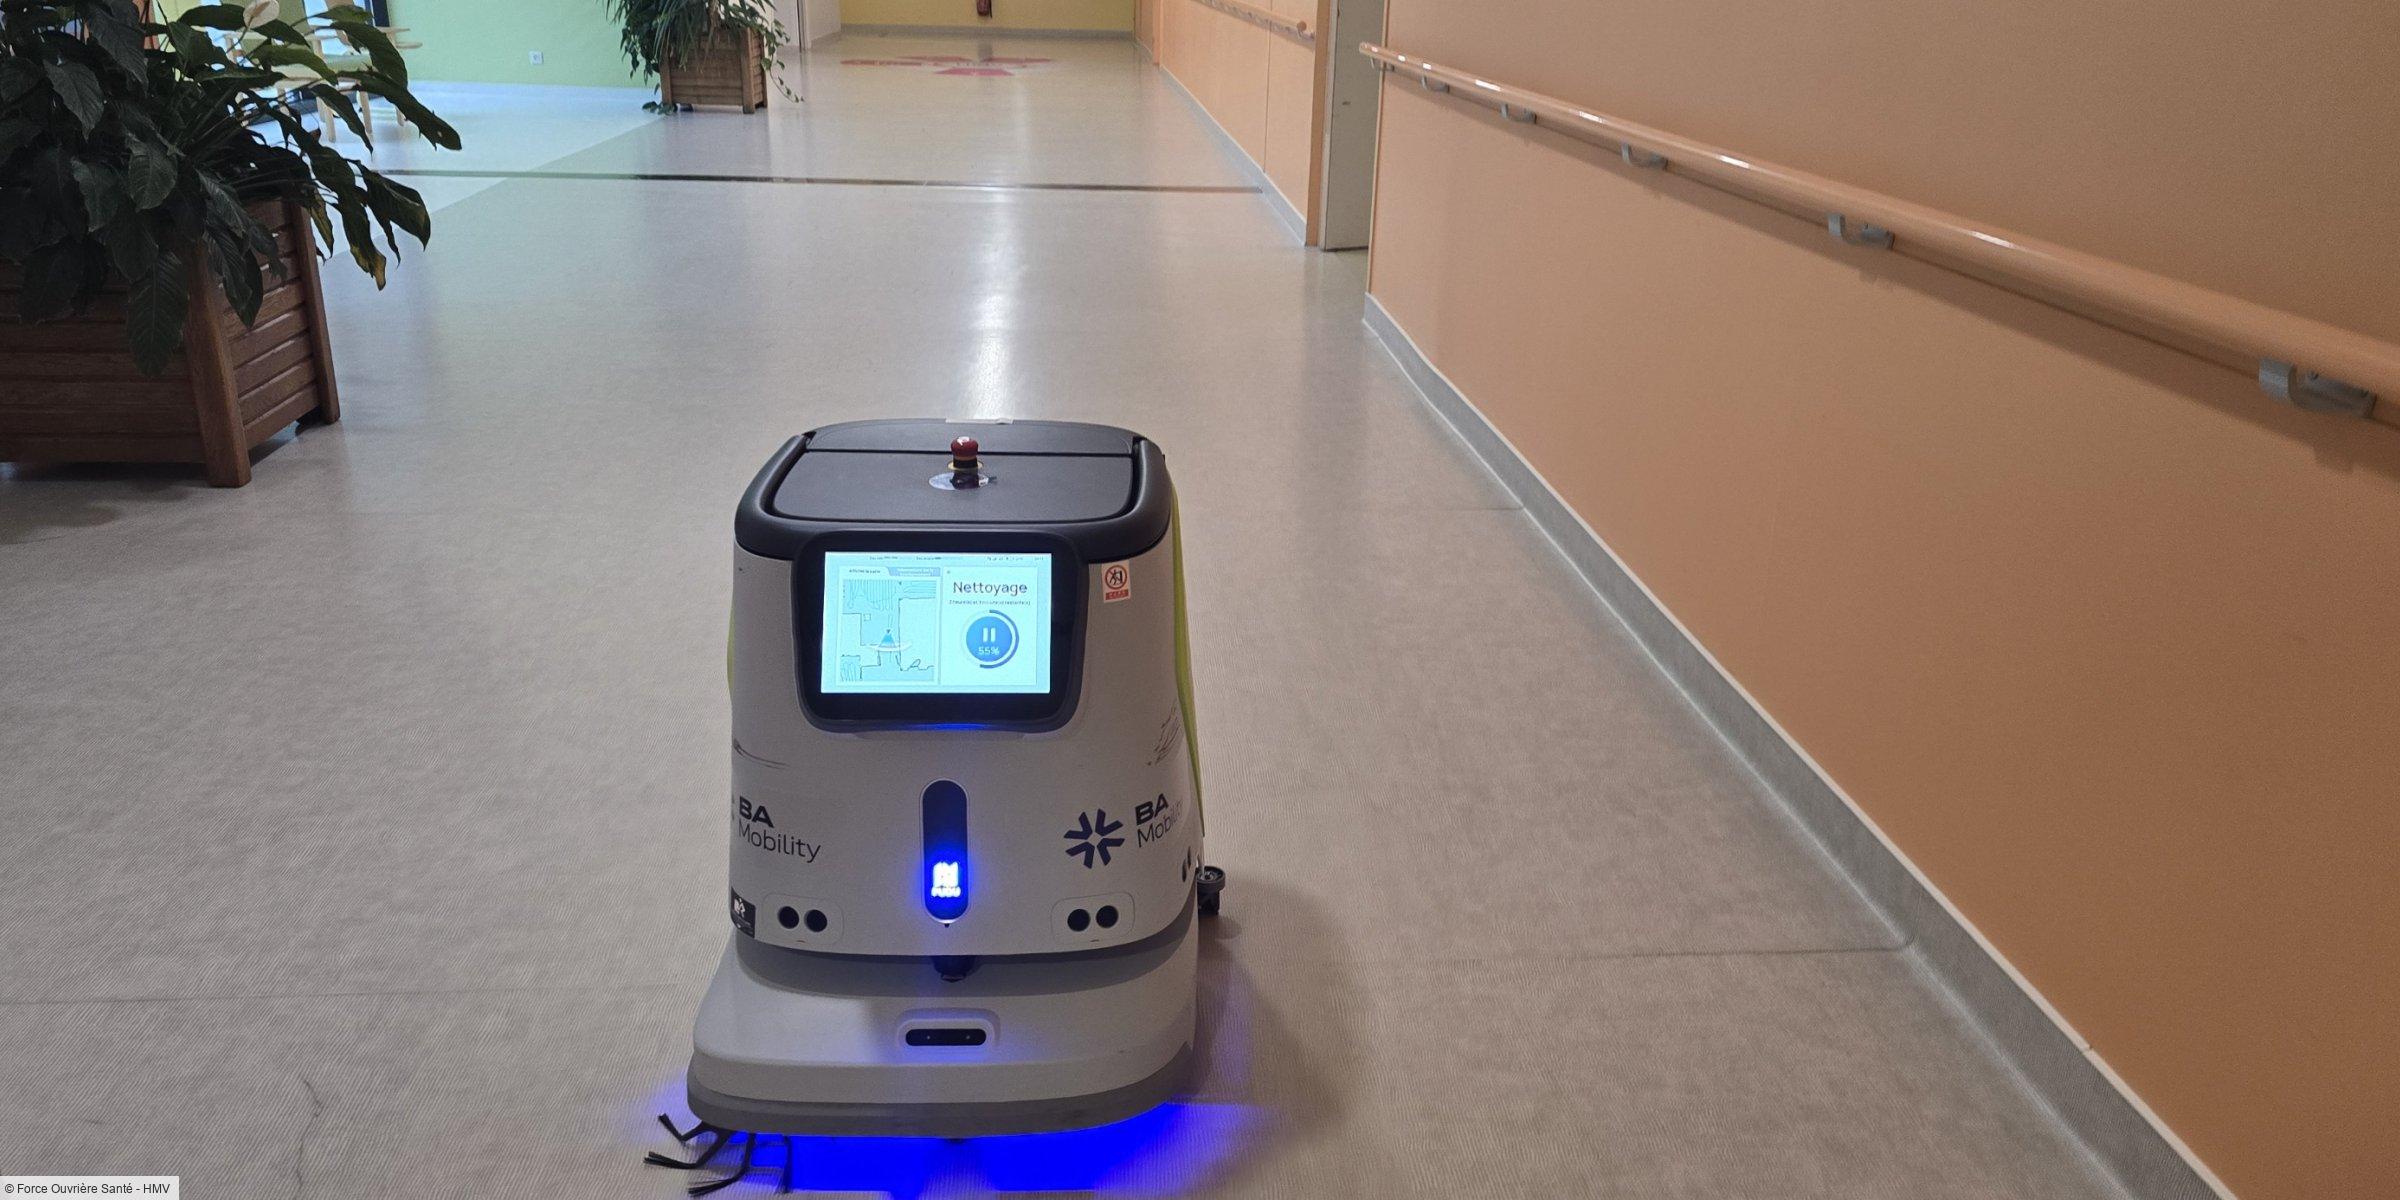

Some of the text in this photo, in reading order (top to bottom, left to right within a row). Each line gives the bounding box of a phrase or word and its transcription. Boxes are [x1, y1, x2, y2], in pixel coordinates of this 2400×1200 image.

[953, 581, 1028, 598] Nettoyage
[977, 645, 1000, 656] 55%
[739, 795, 775, 828] BA
[1135, 793, 1169, 826] BA
[1137, 800, 1183, 848] Mobil
[738, 819, 821, 864] Mobility
